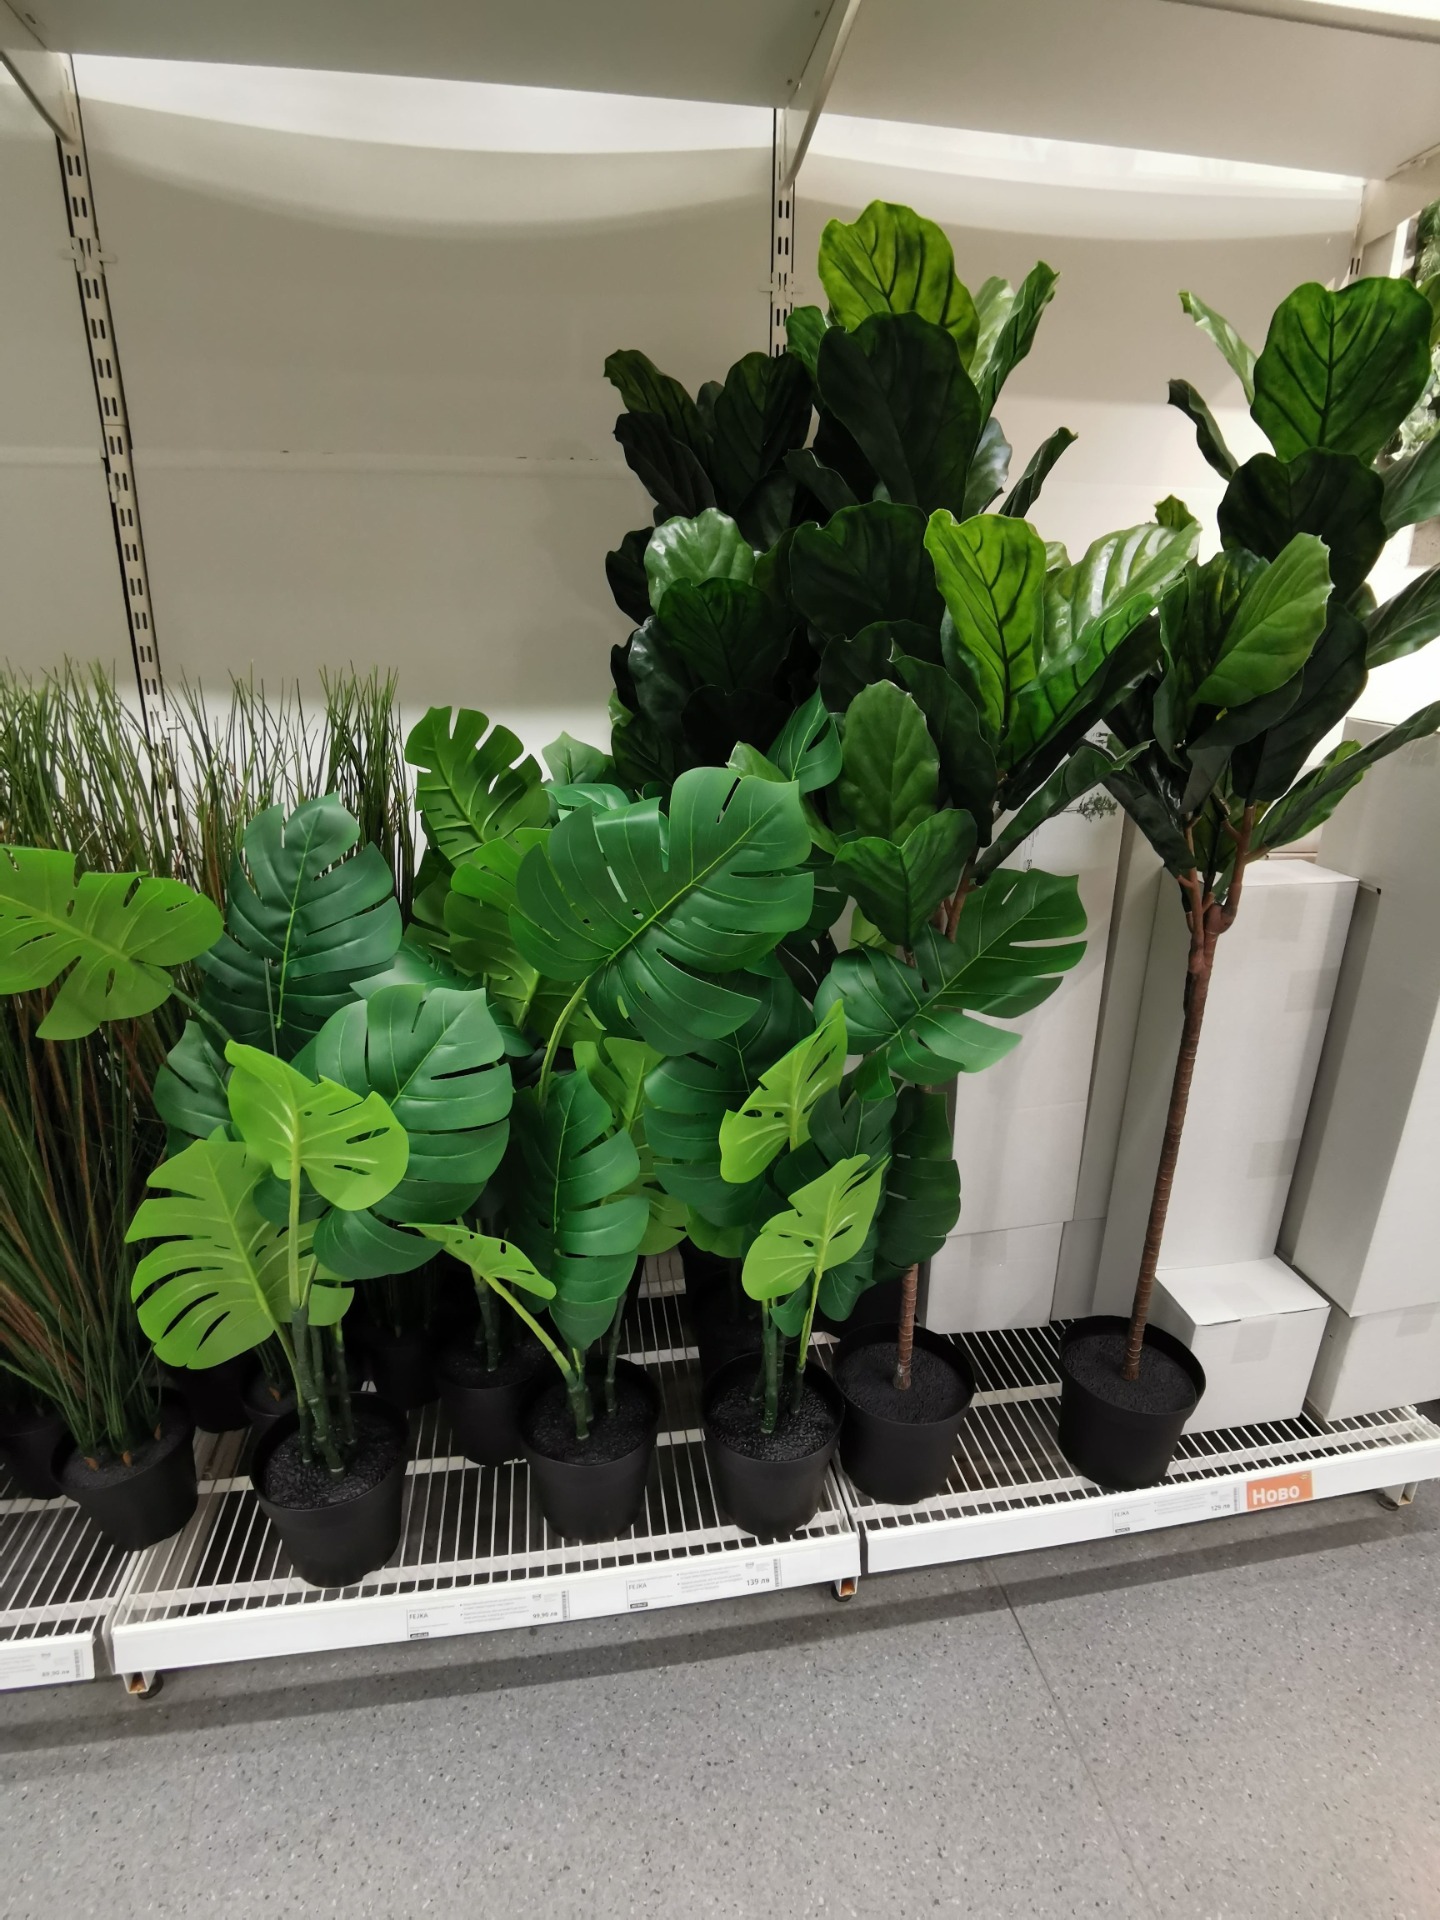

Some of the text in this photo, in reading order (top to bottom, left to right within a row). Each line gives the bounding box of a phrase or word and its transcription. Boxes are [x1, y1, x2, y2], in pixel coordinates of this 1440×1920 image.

[628, 1582, 647, 1590] FEJKA
[747, 1578, 759, 1586] 139
[409, 1612, 429, 1620] FEJKA
